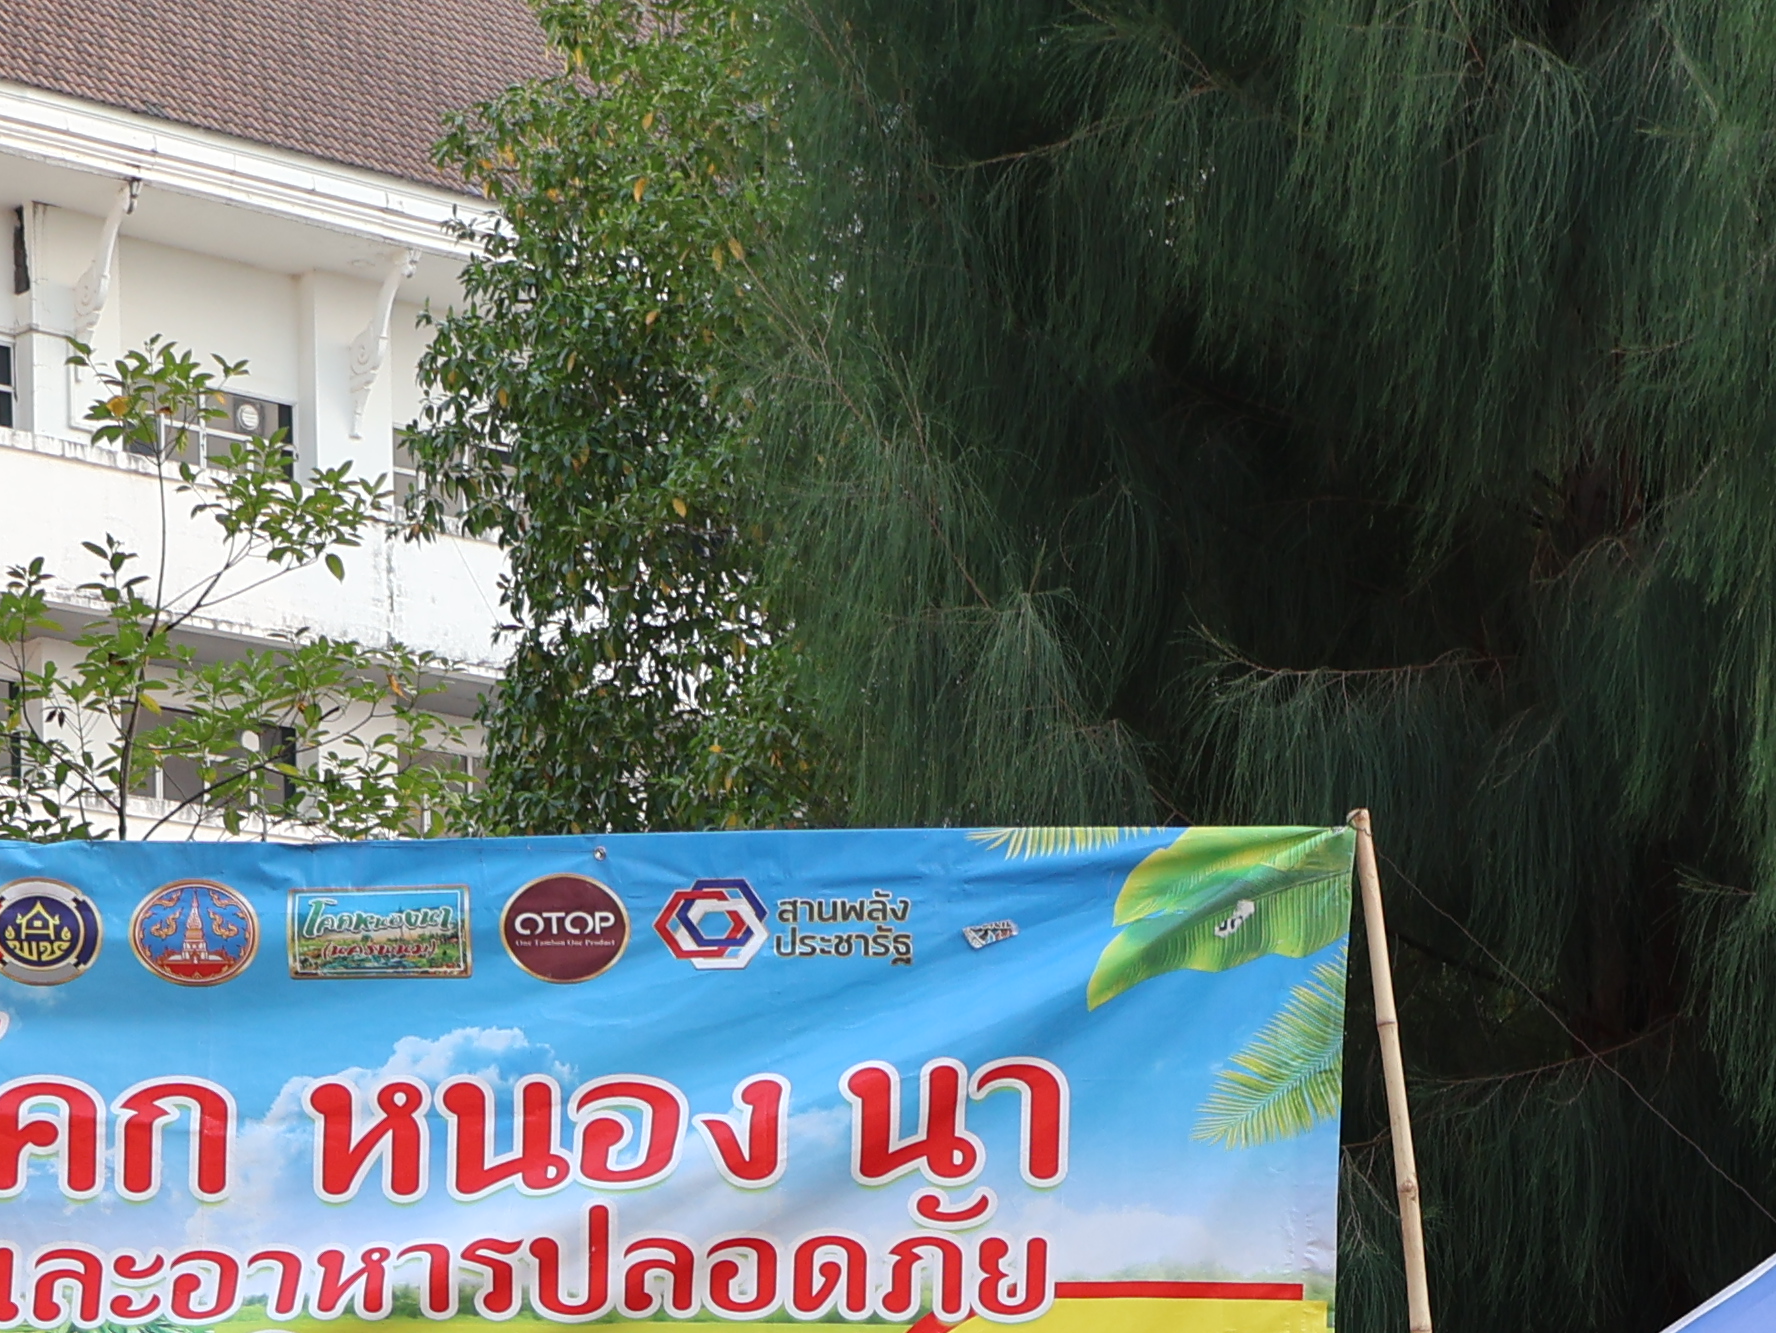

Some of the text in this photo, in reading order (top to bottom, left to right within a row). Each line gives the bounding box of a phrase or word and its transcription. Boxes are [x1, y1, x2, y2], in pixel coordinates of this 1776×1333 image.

[514, 911, 615, 936] OTOP
[777, 889, 912, 923] สานพลัง
[775, 926, 914, 967] ประชารัฐ
[310, 1077, 785, 1198] หนอง
[846, 1060, 1065, 1186] นา
